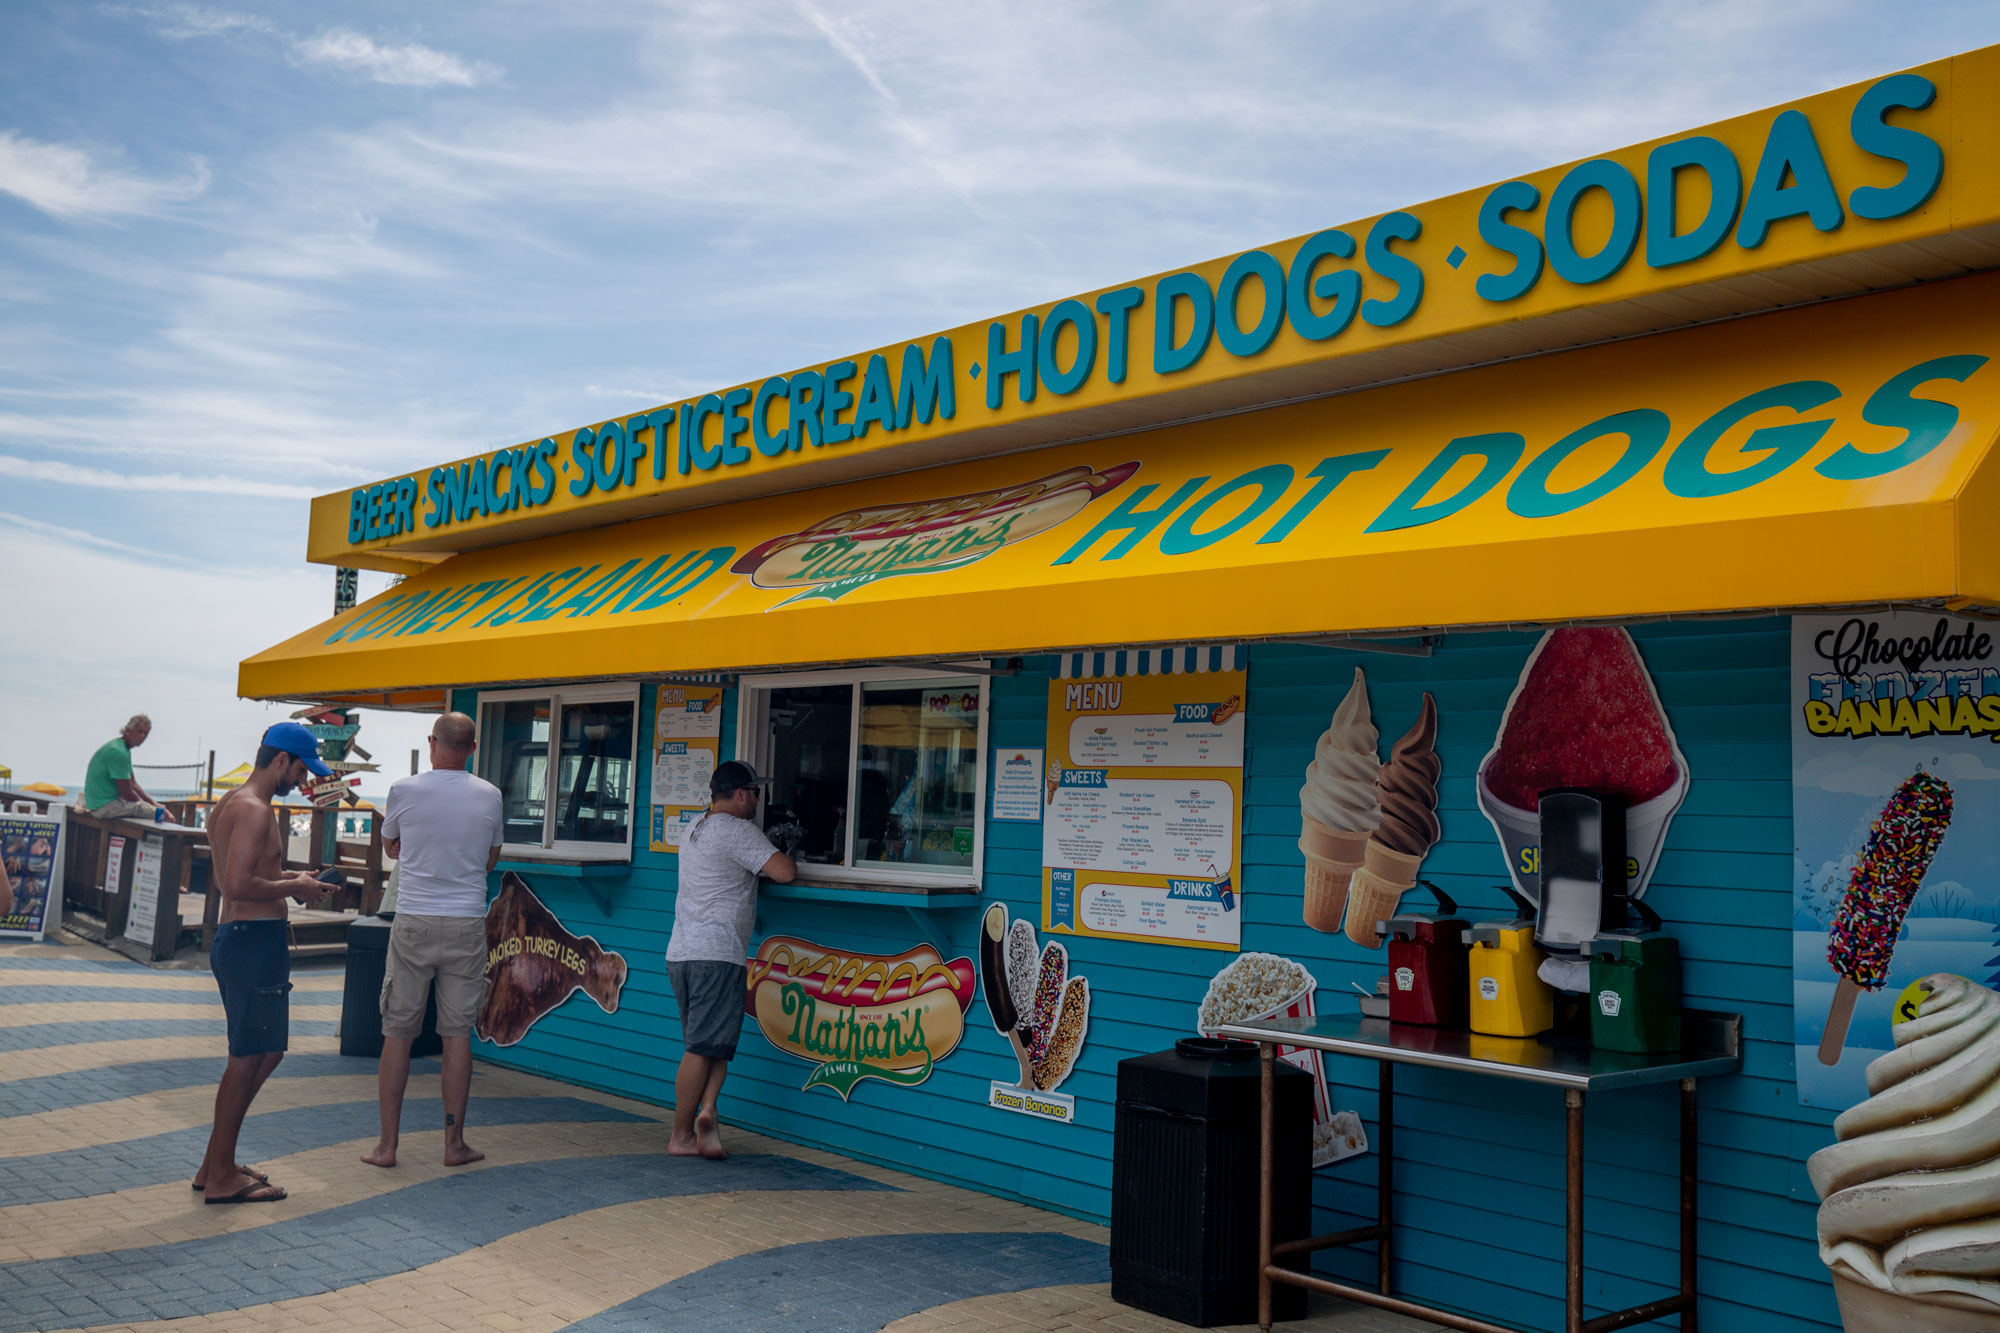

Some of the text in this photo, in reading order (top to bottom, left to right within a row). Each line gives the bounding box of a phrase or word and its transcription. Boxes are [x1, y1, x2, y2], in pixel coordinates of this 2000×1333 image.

[348, 73, 1945, 544] BEER SNACKS SOFT ICE CREAM HOT DOGS SODAS
[1050, 354, 1992, 567] HOT DOGS
[785, 512, 1025, 580] Nathan's
[324, 546, 737, 646] CONEY ISLAND
[1814, 618, 1994, 684] Chocolate
[661, 688, 685, 704] MENU
[689, 701, 703, 711] FOOD
[1065, 681, 1123, 711] MENU
[1180, 704, 1208, 719] FOOD
[1803, 694, 2000, 740] BANANAS
[664, 744, 685, 753] SWEETS
[1064, 771, 1102, 785] SWEETS
[1053, 872, 1072, 881] OTHER
[1174, 881, 1213, 898] DRINKS
[524, 935, 561, 960] TURKEY
[561, 945, 587, 976] LEGS
[781, 981, 926, 1062] Nathan's
[824, 1062, 860, 1077] FAMOUS
[994, 1089, 1067, 1119] Frozen Bananas
